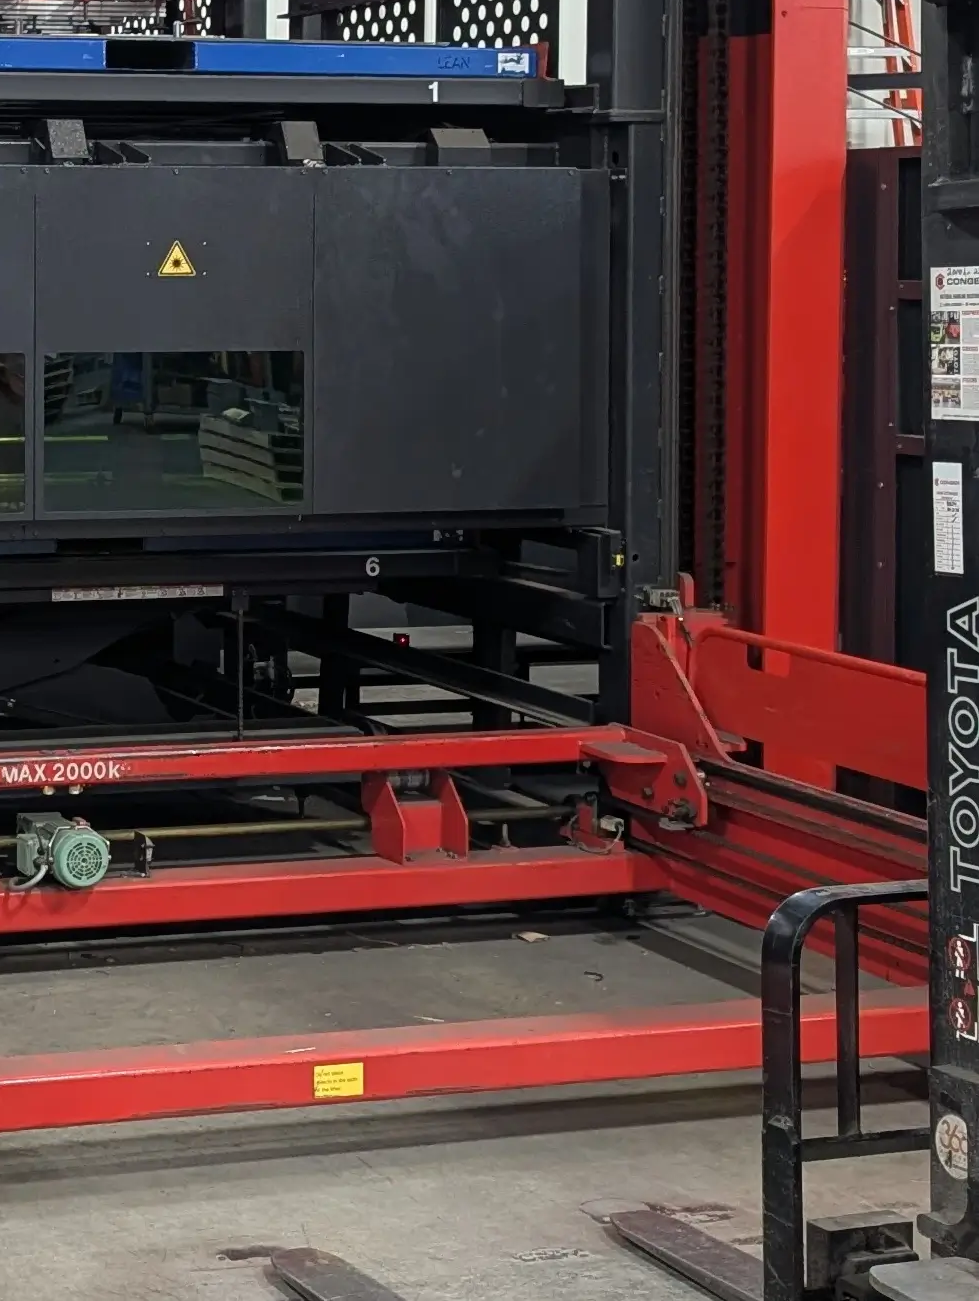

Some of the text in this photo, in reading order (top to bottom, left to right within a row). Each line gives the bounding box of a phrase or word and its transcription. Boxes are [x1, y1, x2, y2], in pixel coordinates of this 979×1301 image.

[437, 55, 470, 70] LEAN
[428, 81, 439, 103] 1
[365, 556, 380, 577] 6
[946, 596, 979, 893] TOYOTA
